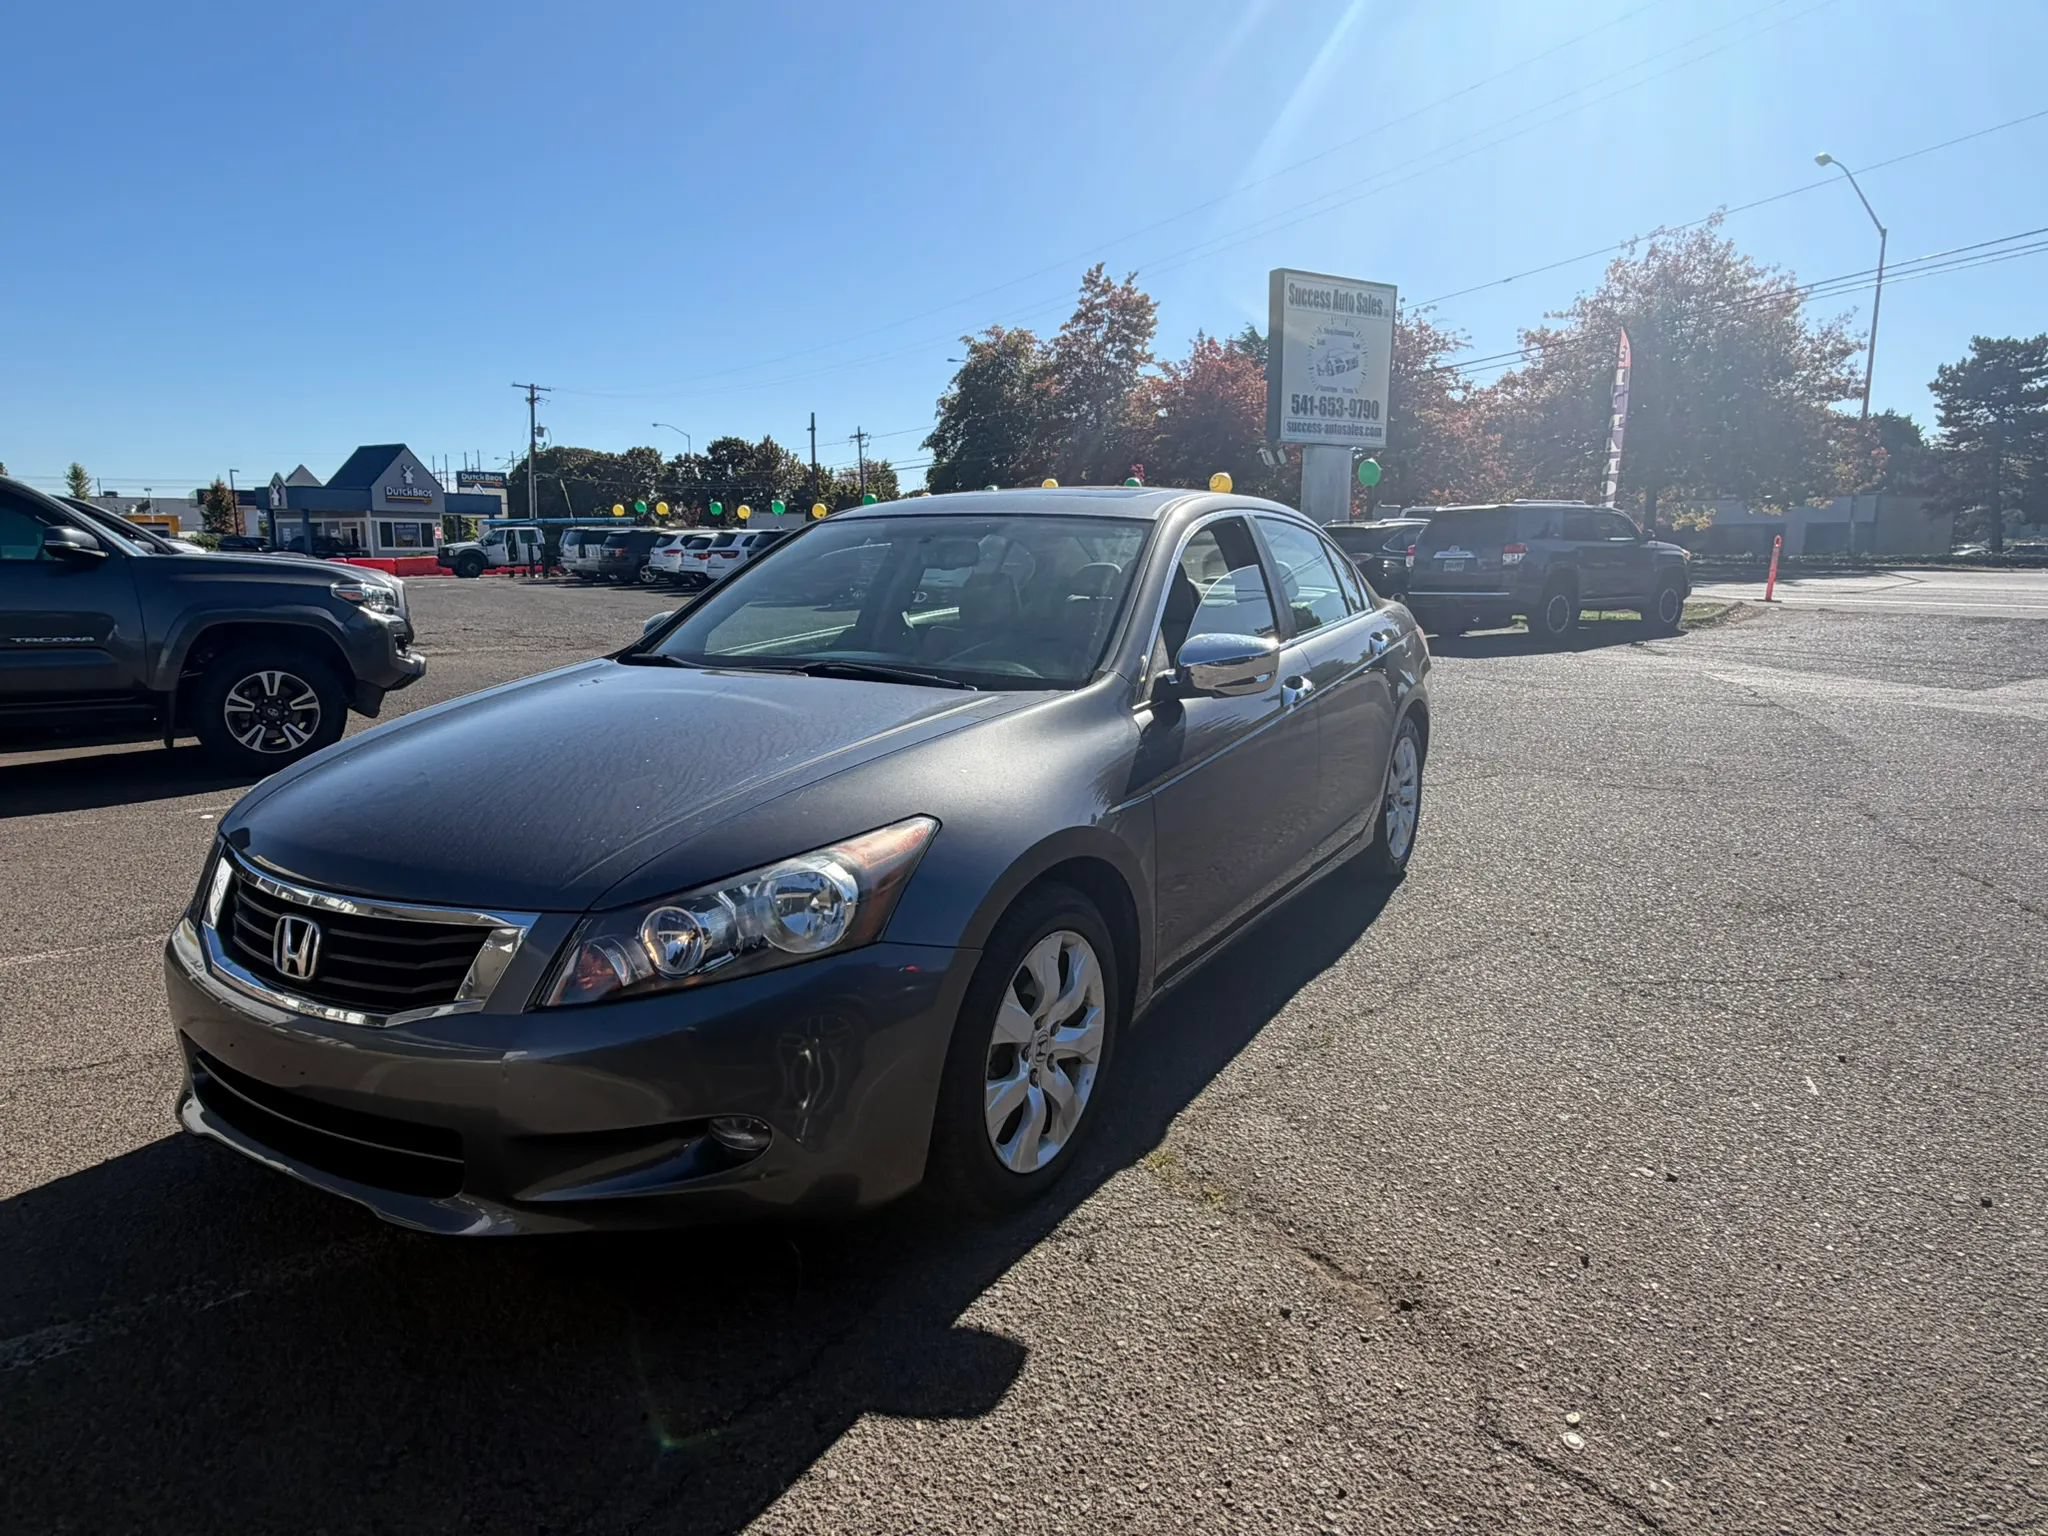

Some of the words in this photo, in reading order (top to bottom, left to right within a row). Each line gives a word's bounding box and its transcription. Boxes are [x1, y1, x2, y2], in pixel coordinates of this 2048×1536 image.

[1289, 283, 1331, 311] Success
[1333, 289, 1355, 313] Auto
[1356, 294, 1383, 316] Sales
[1291, 393, 1379, 420] 541-653-9790
